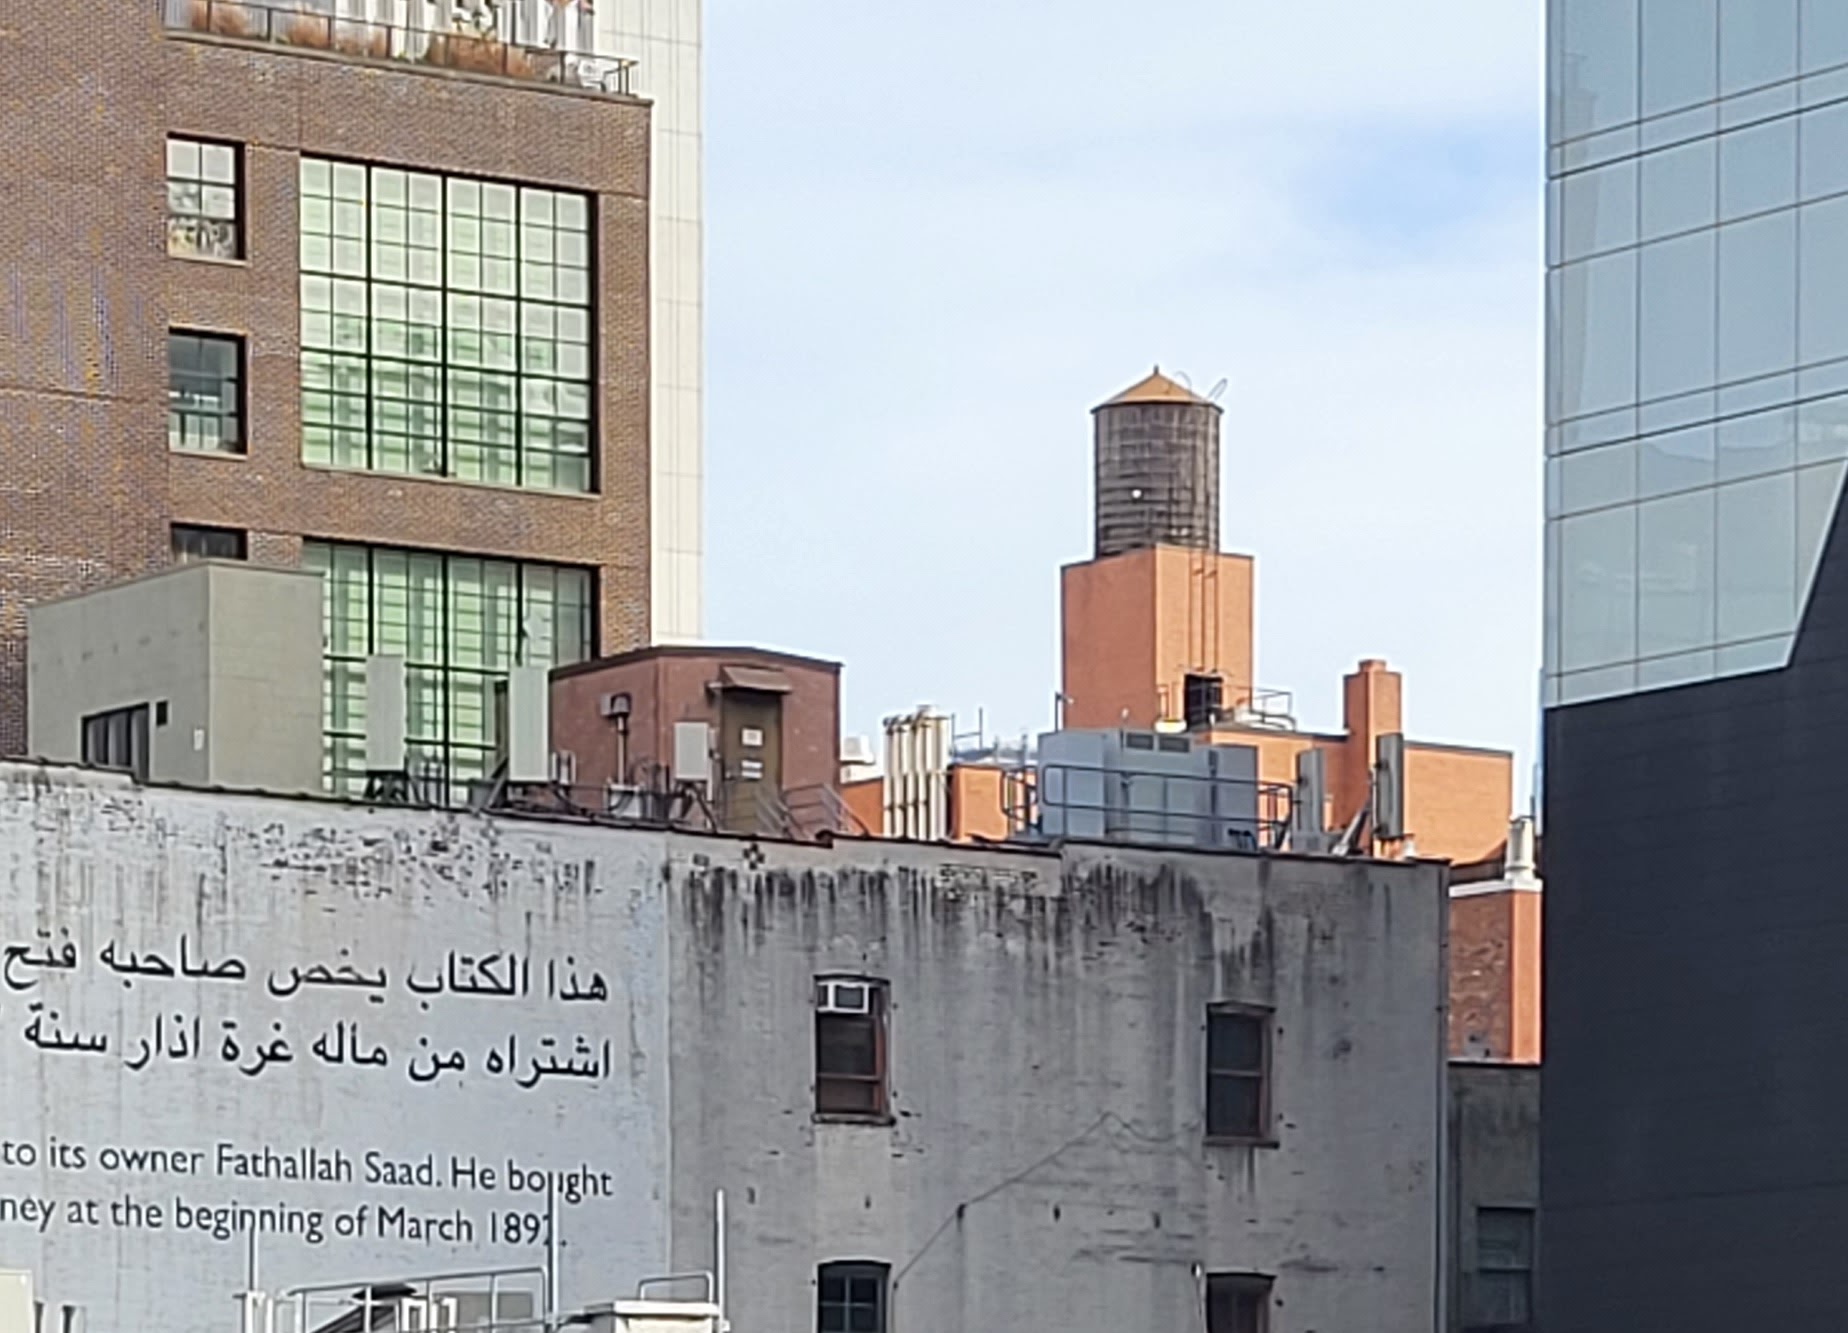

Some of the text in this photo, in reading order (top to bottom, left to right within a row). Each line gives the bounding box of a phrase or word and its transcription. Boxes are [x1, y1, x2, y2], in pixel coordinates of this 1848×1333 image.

[5, 927, 607, 1010] هذا الكتاب يخص صاحبه فتح
[24, 1002, 107, 1052] سنة
[124, 1013, 200, 1070] اذار
[222, 1021, 293, 1076] غرة
[408, 1037, 465, 1081] من
[486, 1034, 610, 1088] اشتراه
[2, 1140, 37, 1166] to
[49, 1136, 86, 1169] its
[99, 1147, 205, 1175] owner
[216, 1143, 351, 1183] Fathallah
[365, 1151, 442, 1187] Saad.
[452, 1156, 496, 1190] He
[0, 1197, 55, 1233] ney
[67, 1200, 100, 1226] at
[110, 1194, 163, 1228] the
[175, 1196, 322, 1244] beginning
[335, 1204, 368, 1237] of
[378, 1206, 473, 1243] March
